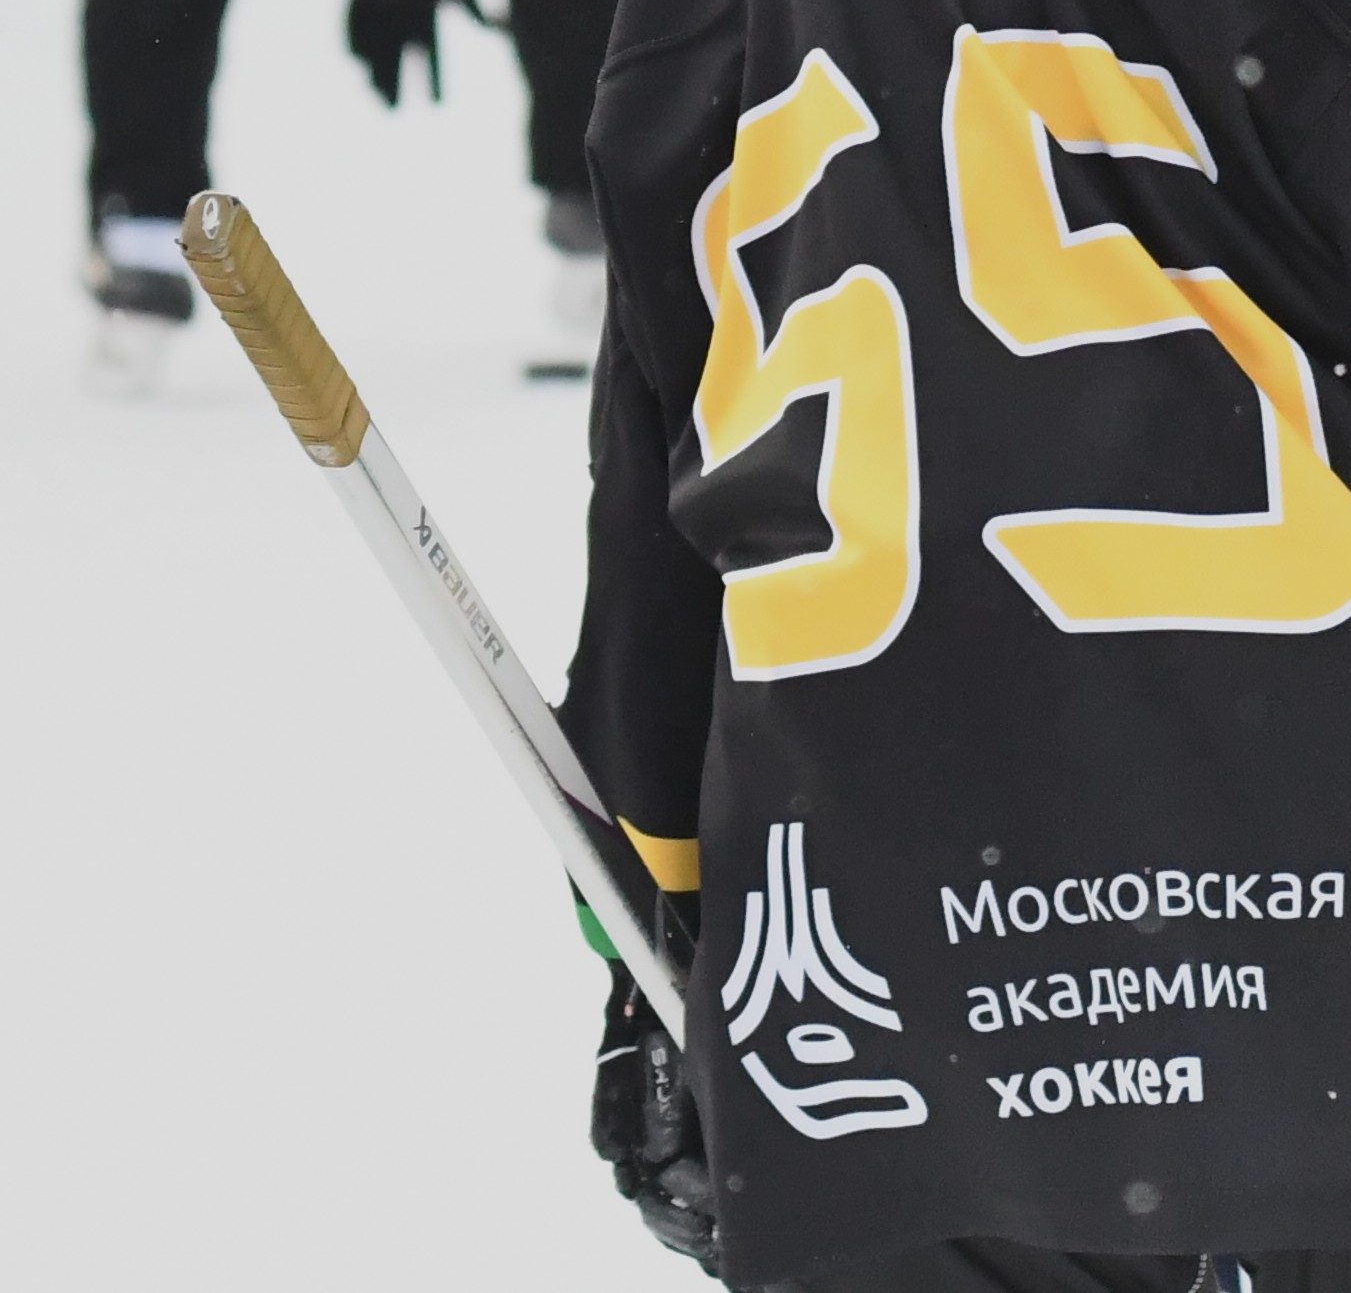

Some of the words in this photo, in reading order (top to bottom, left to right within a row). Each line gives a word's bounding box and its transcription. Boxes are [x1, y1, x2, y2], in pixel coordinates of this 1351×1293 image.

[427, 541, 505, 667] BAUER
[940, 869, 1346, 945] Московская
[967, 962, 1268, 1035] академия
[985, 1055, 1206, 1120] хоккея
